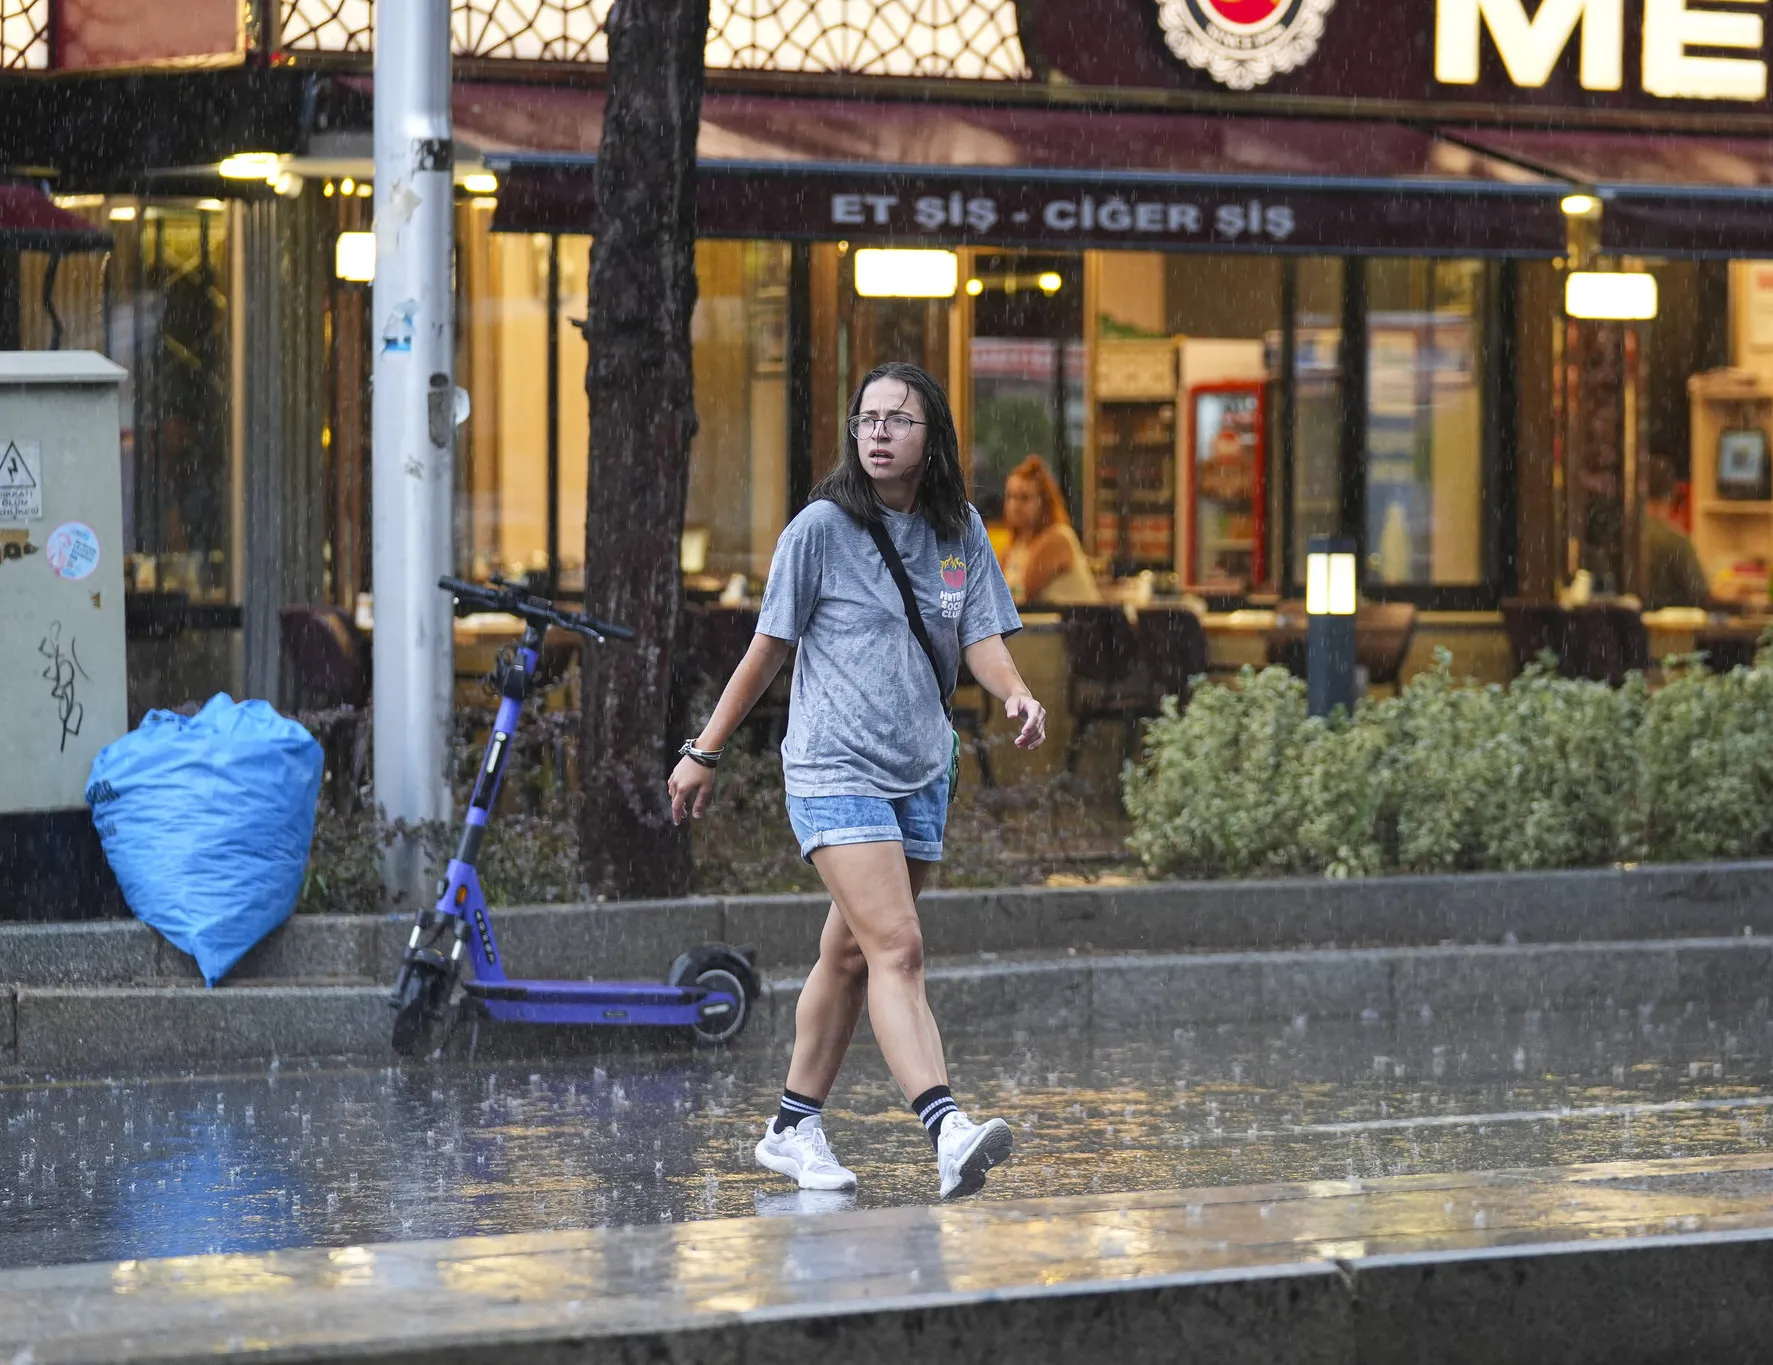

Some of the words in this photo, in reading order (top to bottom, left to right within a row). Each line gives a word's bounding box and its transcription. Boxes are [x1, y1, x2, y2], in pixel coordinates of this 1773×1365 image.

[1434, 0, 1767, 101] ME
[831, 193, 899, 225] ET
[914, 190, 998, 235] ŞİŞ
[1010, 209, 1030, 224] -
[1042, 194, 1200, 233] CİĞER
[1215, 198, 1295, 241] ŞİŞ
